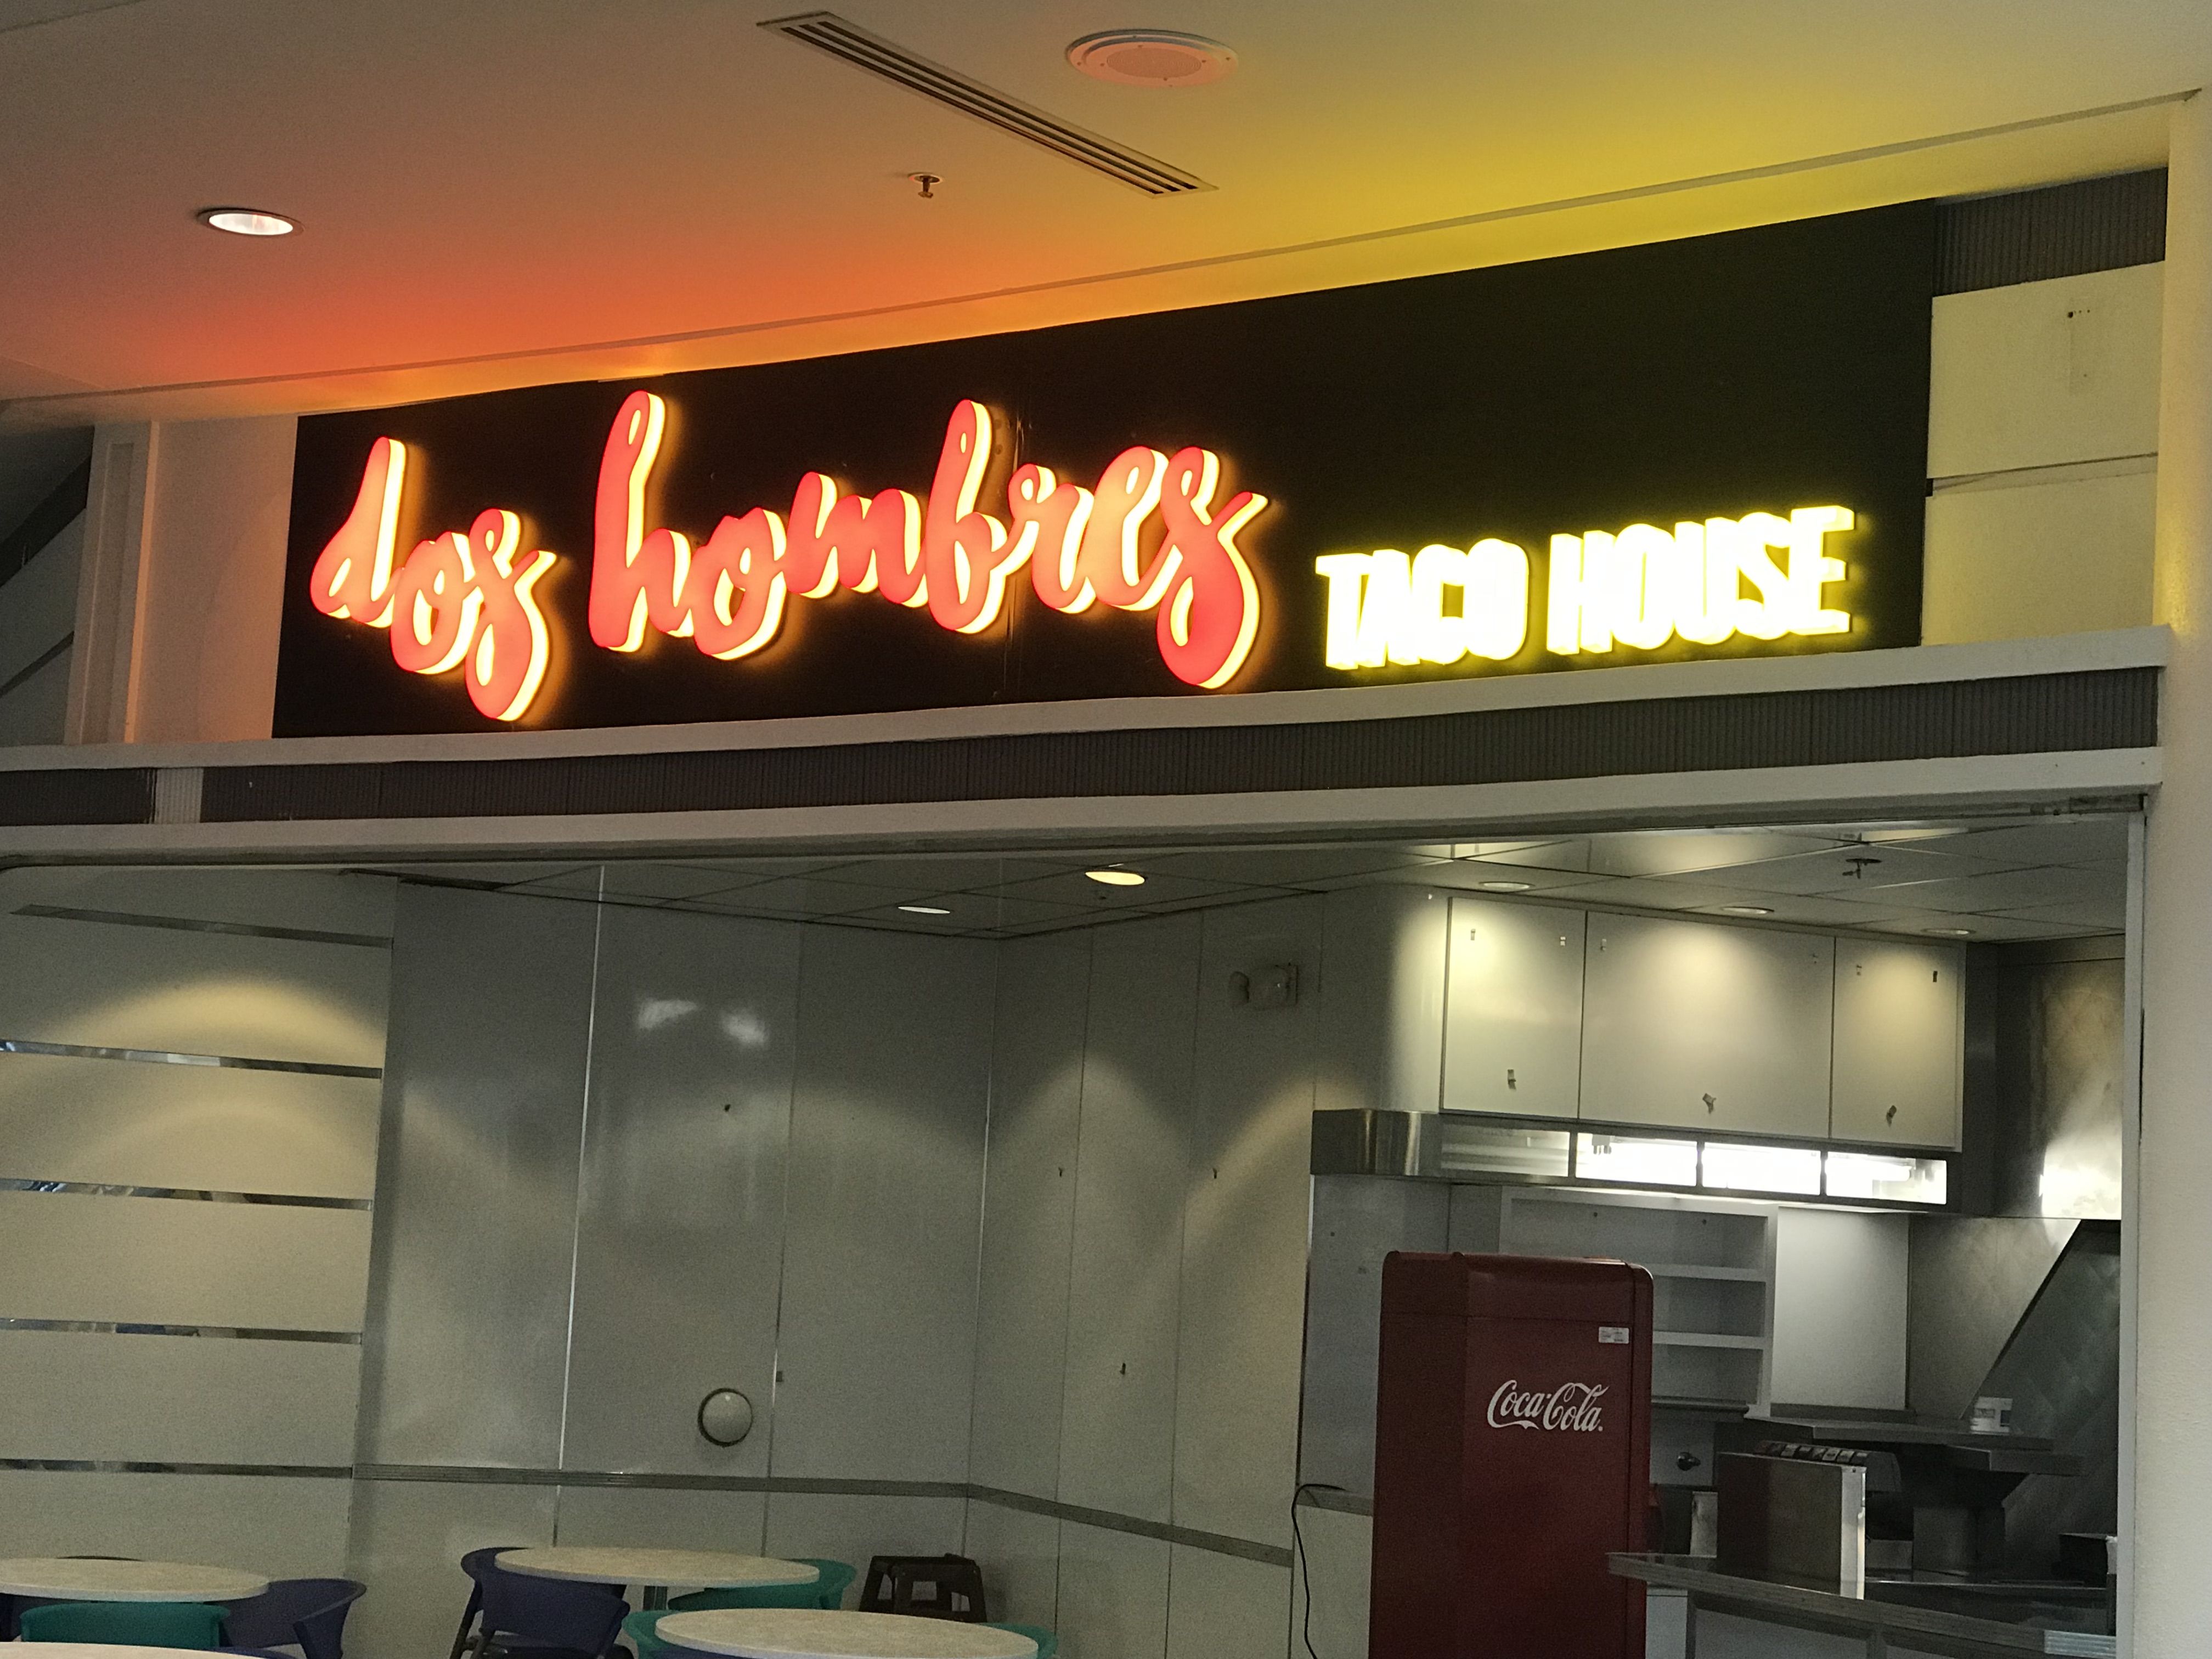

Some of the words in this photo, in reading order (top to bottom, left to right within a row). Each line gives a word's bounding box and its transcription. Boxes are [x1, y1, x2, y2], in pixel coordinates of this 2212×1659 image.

[309, 436, 556, 722] dos
[588, 390, 1269, 689] hombres
[1315, 538, 1529, 670] TACO
[1546, 505, 1855, 655] HOUSE
[1487, 1379, 1610, 1432] Coca-Cola
